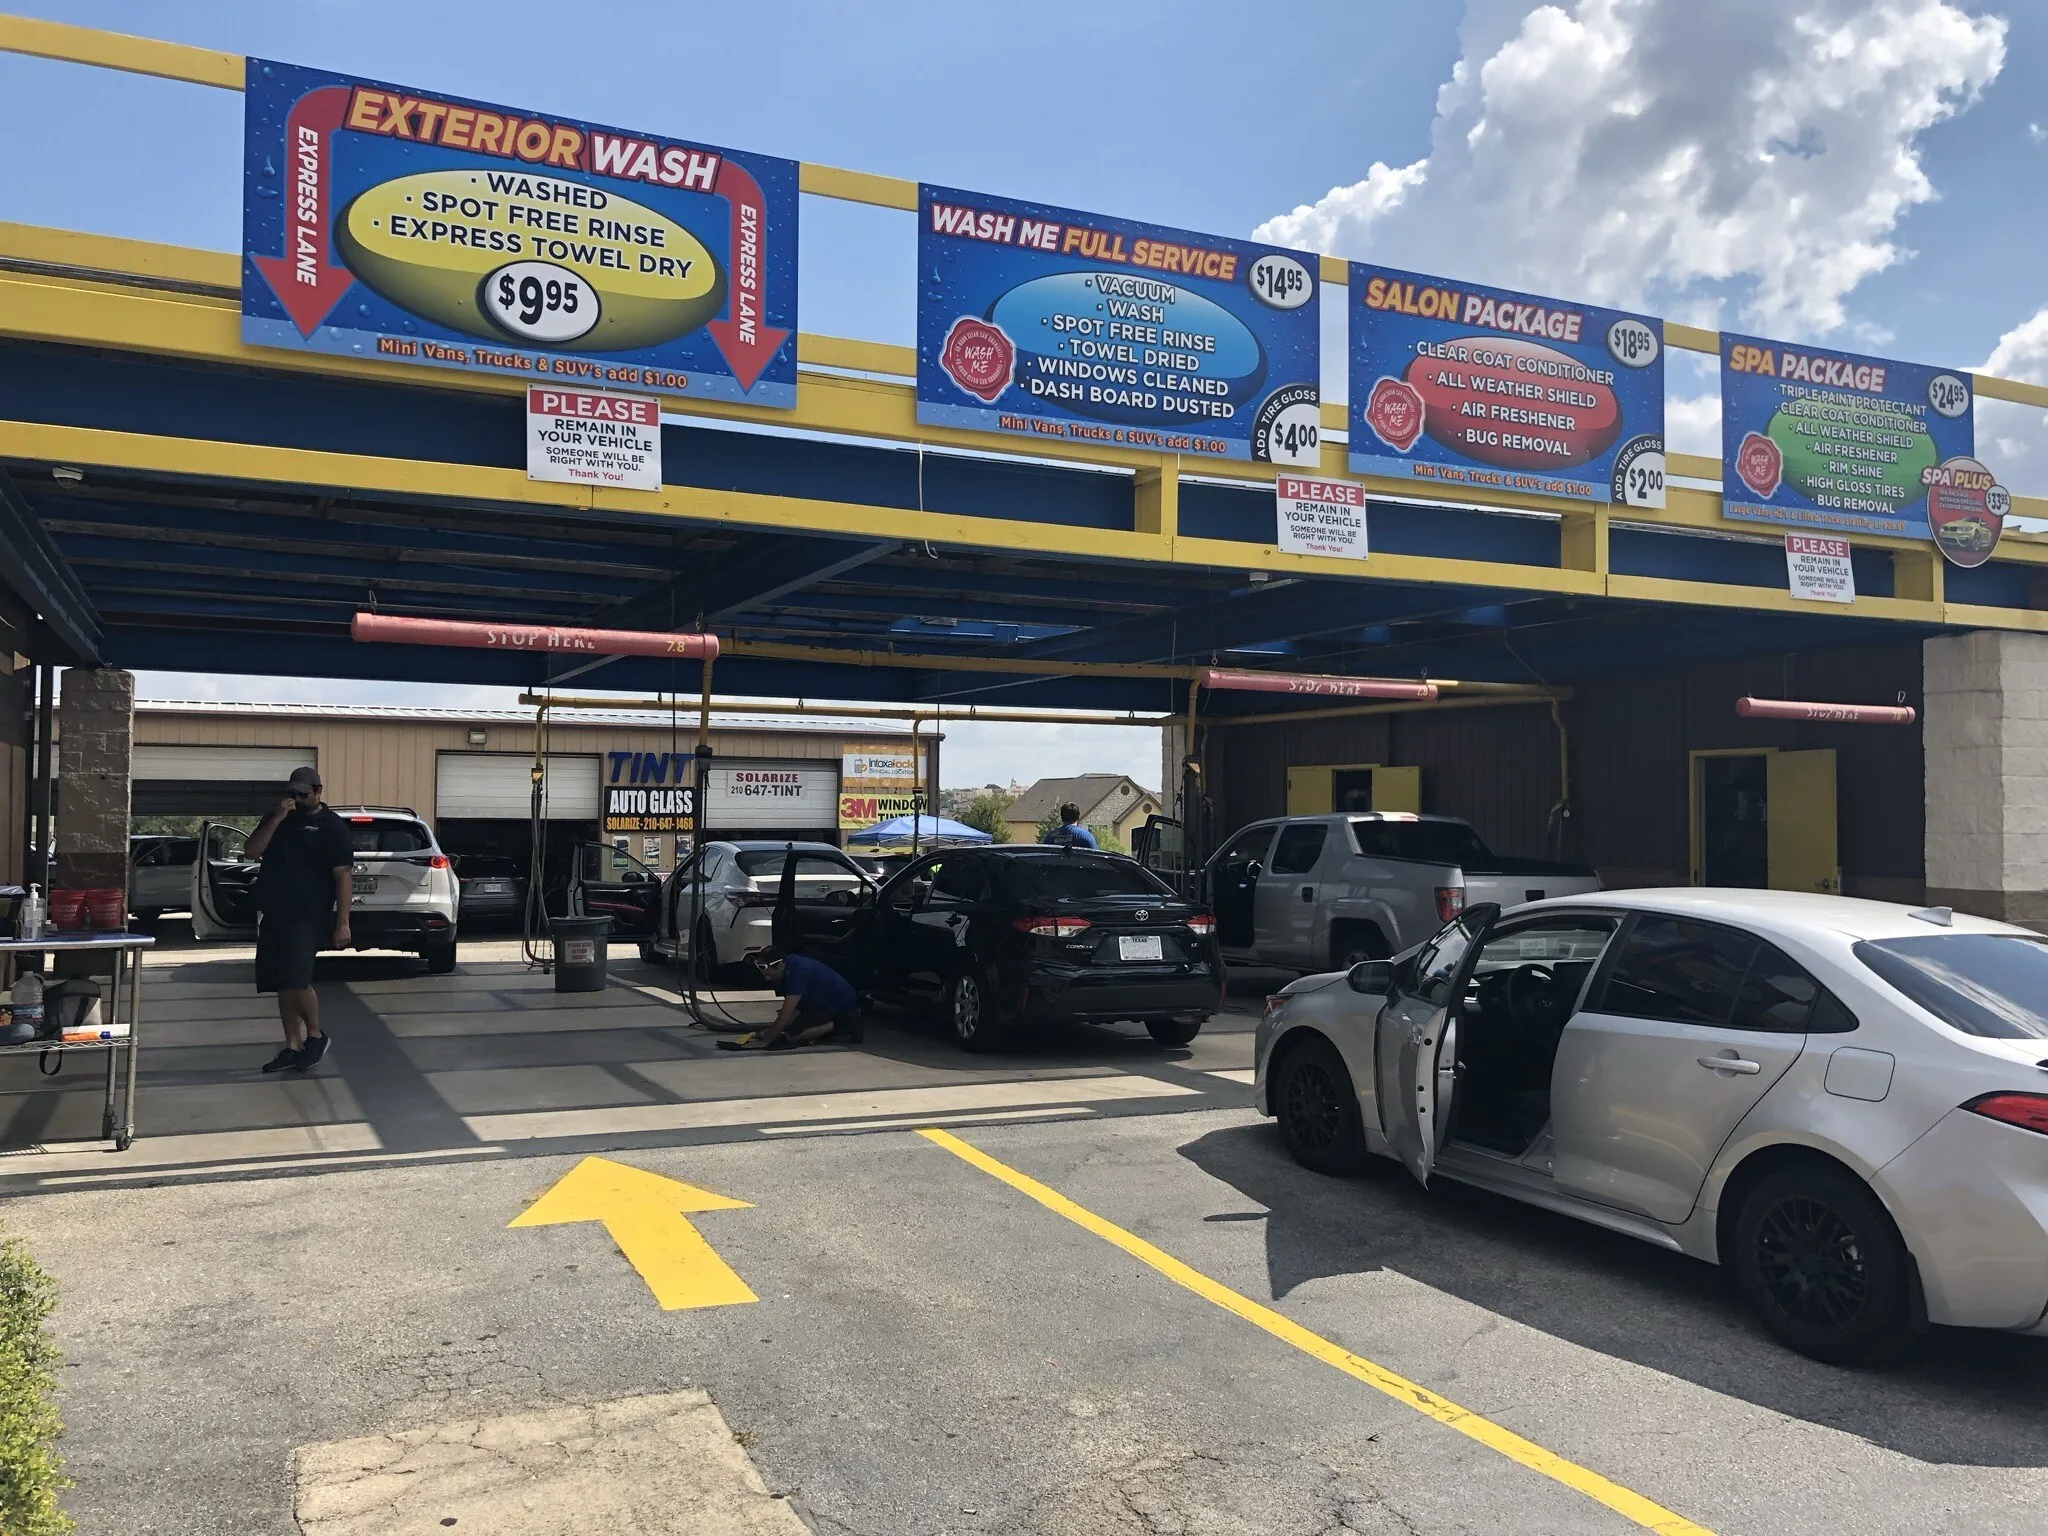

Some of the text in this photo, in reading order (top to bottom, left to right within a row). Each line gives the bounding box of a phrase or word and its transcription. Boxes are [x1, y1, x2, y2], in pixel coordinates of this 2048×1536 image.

[349, 89, 718, 191] EXTERIOR WASH
[486, 173, 608, 210] WASHED
[296, 126, 318, 286] EXPRESS LANE
[422, 191, 665, 248] SPOT FREE RINSE
[390, 217, 693, 279] EXPRESS TOWEL DRY
[932, 205, 1237, 280] WASH ME FULL SERVICE
[738, 203, 757, 345] EXPRESS LANE
[1096, 276, 1176, 303] VACUUM
[1109, 301, 1164, 323] WASH
[1366, 277, 1582, 343] SALON PACKAGE
[1053, 315, 1216, 353] SPOT FREE RINSE
[379, 339, 688, 389] Mini Vans, Trucks & SUV's add $1.00
[965, 346, 994, 359] WASH
[1070, 338, 1199, 371] TOWEL DRIED
[1417, 341, 1614, 385] CLEAR COAT CONDITIONER
[971, 360, 988, 373] ME
[1038, 357, 1229, 397] WINDOWS CLEANED
[1730, 345, 1885, 392] SPA PACKAGE
[1031, 378, 1235, 419] DASH BOARD DUSTED
[1437, 372, 1596, 408] ALL WEATHER SHIELD
[1780, 384, 1926, 416] TRIPLE PAINT PROTECTANT
[543, 393, 646, 422] PLEASE
[1385, 403, 1407, 414] WASH
[1461, 402, 1575, 430] AIR FRESHENER
[1781, 402, 1927, 433] CLEAR COAT CONDITIONER
[555, 419, 636, 437] REMAIN IN
[1257, 390, 1316, 457] ADD TIRE GLOSS
[1390, 415, 1403, 426] ME
[538, 430, 652, 451] YOUR VEHICLE
[1001, 416, 1226, 454] Mini Vans, Trucks & SUV's add $1.00
[1466, 429, 1571, 456] BUG REMOVAL
[1796, 422, 1913, 448] ALL WEATHER SHIELD
[546, 447, 644, 463] SOMEONE WILL BE
[550, 456, 641, 471] RIGHT WITH YOU.
[1618, 449, 1634, 470] TIRE
[1634, 440, 1661, 452] GLOSS
[1813, 442, 1898, 463] AIR FRESHENER
[569, 469, 624, 481] Thank You!
[1415, 464, 1436, 477] Mini
[1470, 471, 1501, 485] Trucks
[1505, 476, 1512, 485] &
[1546, 482, 1563, 492] add
[1829, 461, 1883, 478] RIM SHINE
[1922, 468, 1993, 490] SPA PLUS
[1287, 482, 1356, 504] PLEASE
[1807, 476, 1905, 498] HIGH GLOSS TIRES
[1296, 502, 1350, 516] REMAIN IN
[1818, 494, 1895, 514] BUG REMOVAL
[1285, 512, 1361, 527] YOUR VEHICLE
[1291, 525, 1326, 534] SOMEONE
[1293, 532, 1315, 540] RIGHT
[1306, 543, 1326, 551] Thank
[1793, 538, 1844, 556] PLEASE
[1793, 564, 1848, 576] YOUR VEHICLE
[1801, 556, 1830, 565] REMAIN
[488, 629, 539, 646] STOP
[547, 634, 596, 650] HERE
[608, 752, 694, 783] TINT
[736, 773, 798, 782] SOLARIZE
[609, 790, 693, 814] AUTO GLASS
[731, 784, 802, 796] 210 647-TINT
[841, 798, 877, 818] 3M
[878, 799, 927, 810] WINDOW
